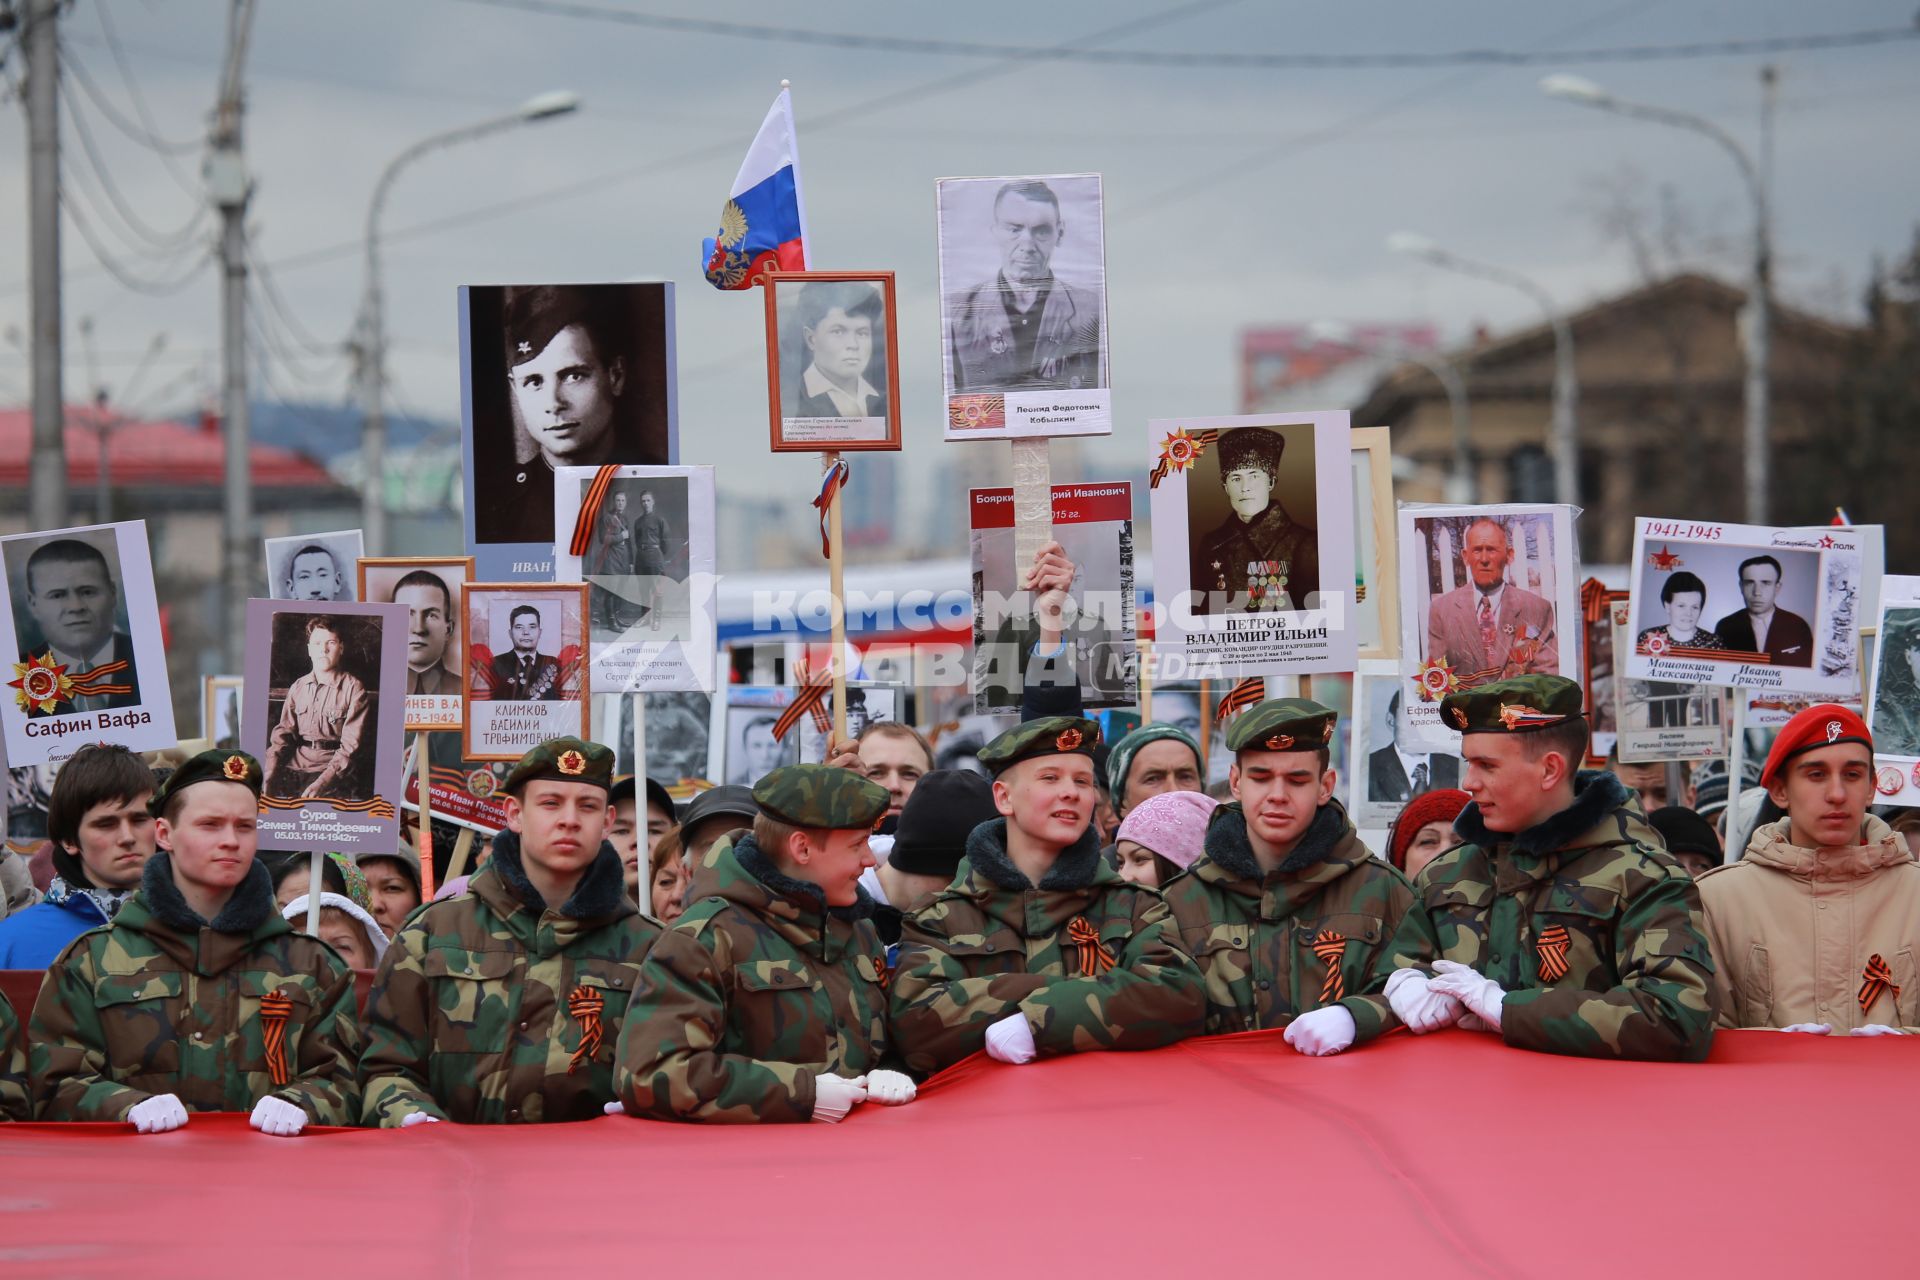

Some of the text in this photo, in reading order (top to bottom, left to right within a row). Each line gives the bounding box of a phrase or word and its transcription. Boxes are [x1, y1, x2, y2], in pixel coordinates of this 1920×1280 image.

[1016, 403, 1100, 414] Леонид Федотович
[1030, 415, 1076, 424] Кобылкин
[1073, 487, 1125, 498] Иванович
[1644, 521, 1722, 540] 1941-1945
[512, 561, 551, 573] ИВАН
[1226, 617, 1286, 631] ПЕТРОВ
[1186, 627, 1328, 646] ВЛАДИМИР ИЛЬИЧ
[599, 659, 682, 669] Александр Сергеевич
[1648, 658, 1782, 678] Мошонкина Иванов
[635, 671, 675, 681] Сергеевич
[1646, 669, 1783, 687] Александра Григорий
[495, 704, 548, 716] КЛИМКОВ
[25, 710, 151, 738] Сафин Вафа
[449, 791, 474, 806] Иван
[300, 809, 337, 821] Суров
[256, 819, 382, 834] Семен Тимофеевич
